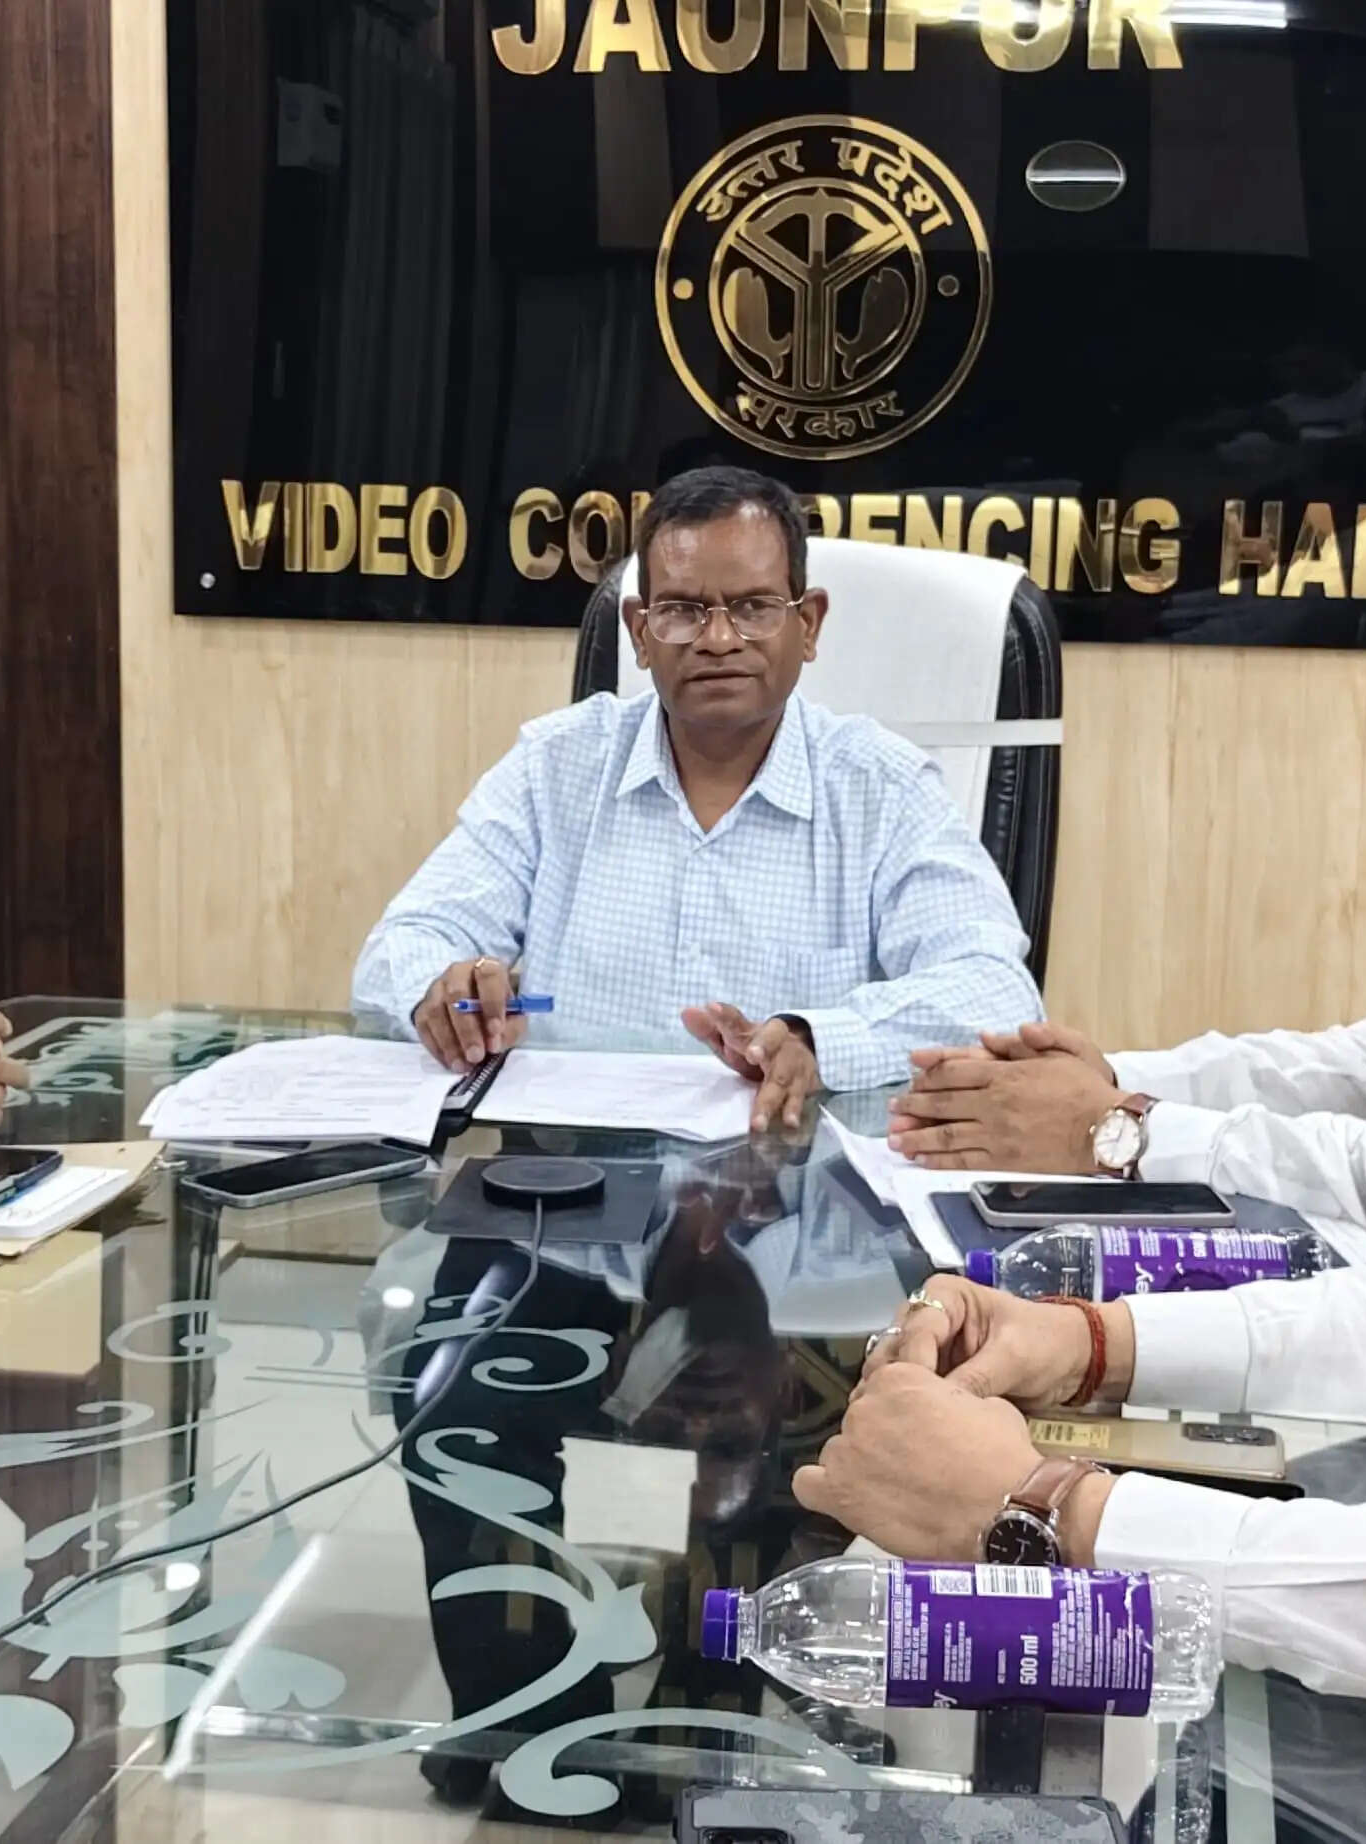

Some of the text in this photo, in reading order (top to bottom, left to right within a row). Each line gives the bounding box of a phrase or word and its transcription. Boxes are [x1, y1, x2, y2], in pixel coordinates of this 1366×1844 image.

[695, 136, 954, 235] उत्तर प्रदेश
[736, 380, 904, 439] सरकार
[221, 479, 468, 580] VIDEO
[1019, 1634, 1039, 1685] 500 ml
